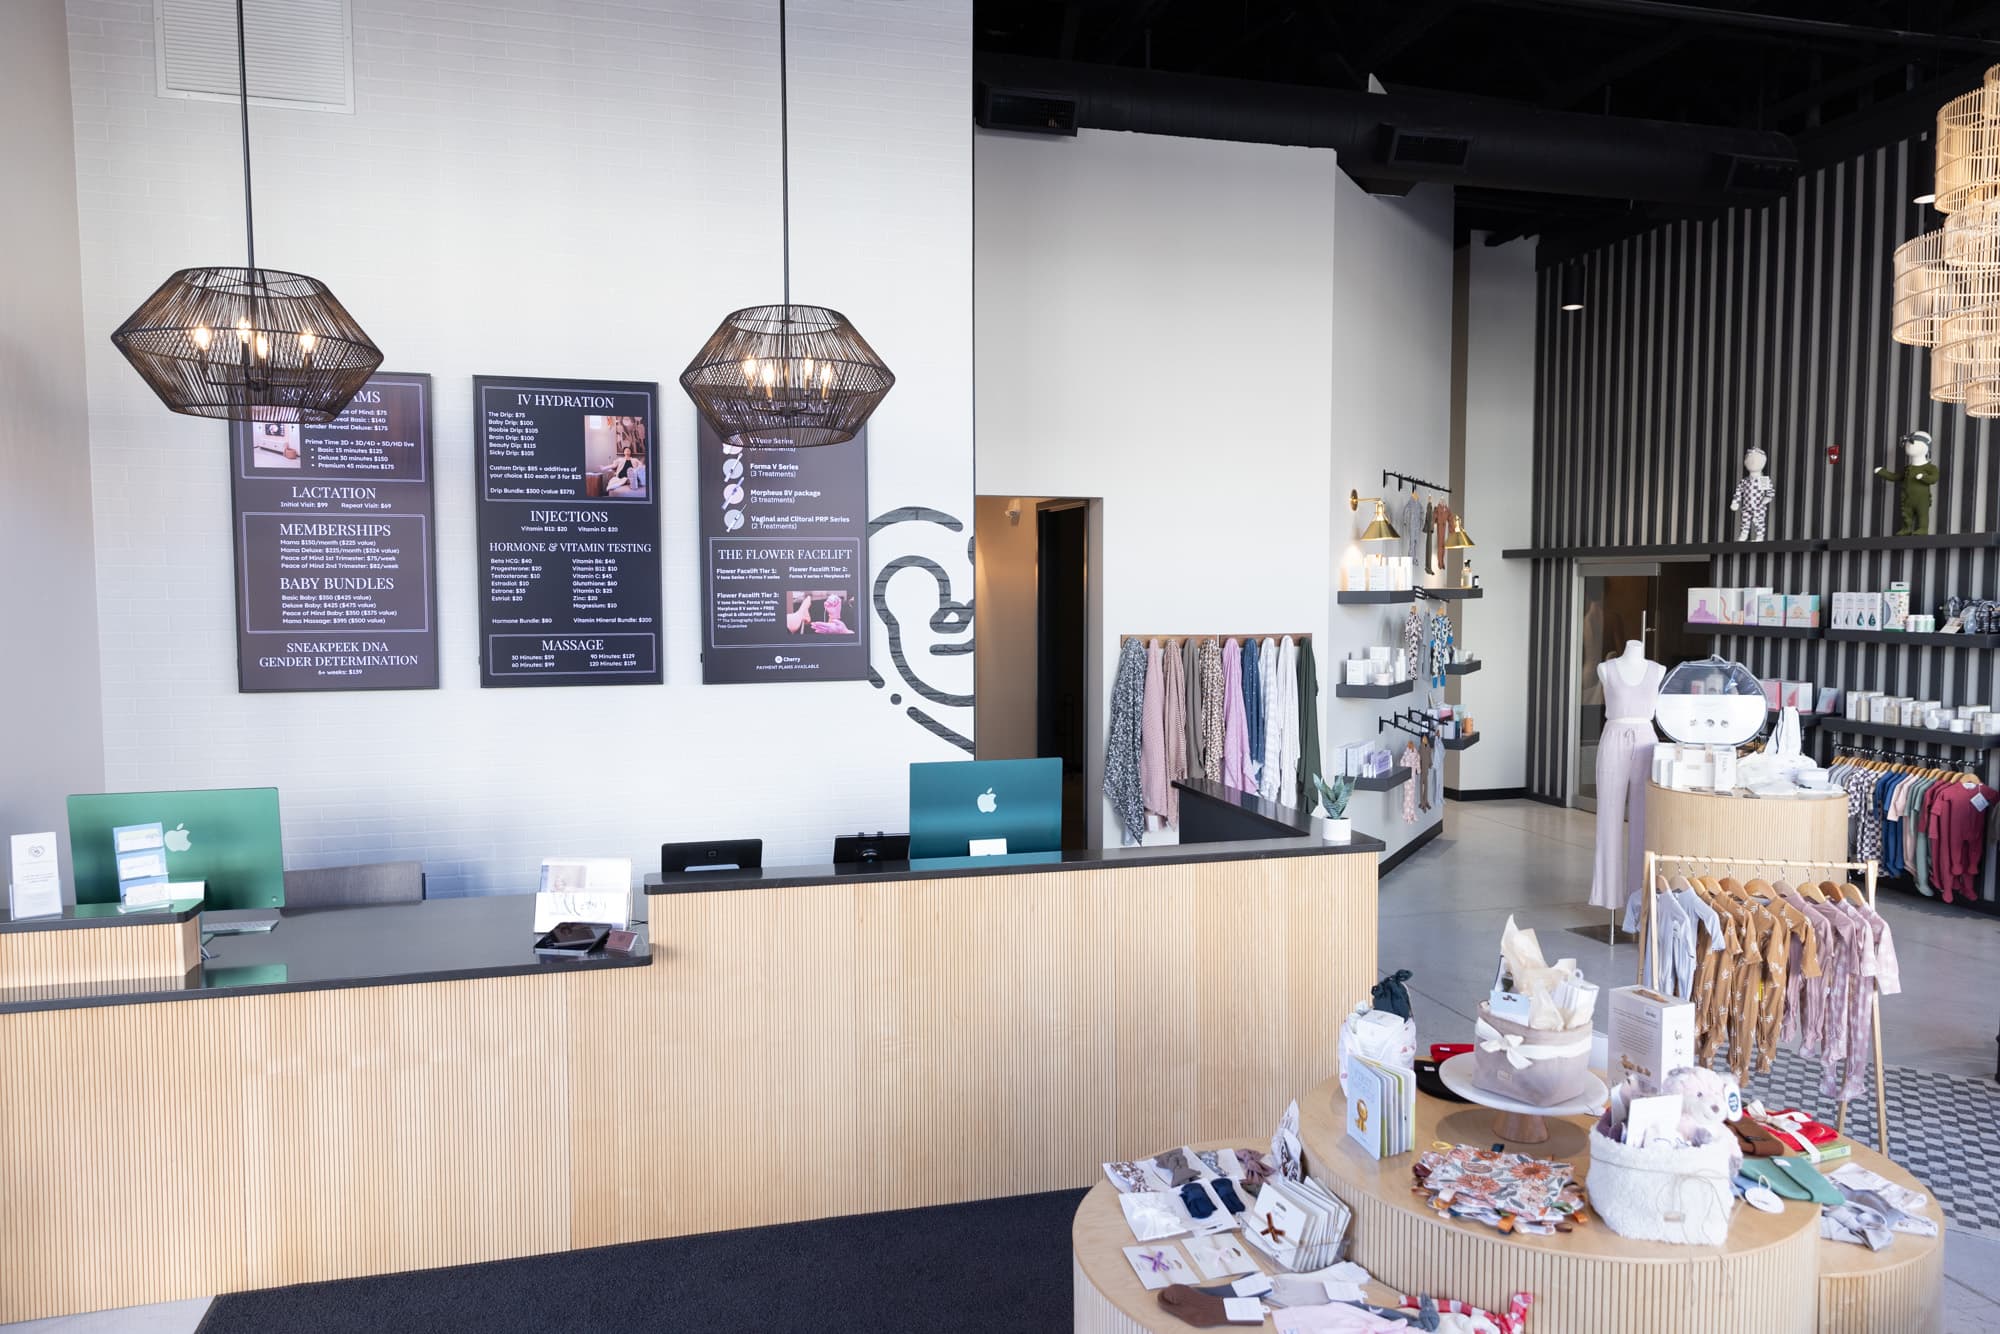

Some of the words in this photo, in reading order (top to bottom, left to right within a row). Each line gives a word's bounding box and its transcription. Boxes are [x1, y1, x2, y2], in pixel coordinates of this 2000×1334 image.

[518, 394, 531, 406] IV
[535, 395, 614, 408] HYDRATION
[293, 486, 376, 499] LACTATION
[531, 510, 608, 523] INJECTIONS
[280, 523, 391, 537] MEMBERSHIPS
[490, 543, 546, 552] HORMONE
[548, 543, 558, 552] &
[560, 543, 604, 552] VITAMIN
[607, 543, 651, 552] TESTING
[718, 550, 743, 560] THE
[746, 550, 795, 560] FLOWER
[797, 549, 853, 560] FACELIFT
[281, 578, 319, 590] BABY
[324, 578, 394, 590] BUNDLES
[287, 642, 359, 653] SNEAKPEEK
[362, 642, 388, 652] DNA
[542, 640, 603, 651] MASSAGE
[259, 656, 312, 667] GENDER
[315, 655, 418, 667] DETERMINATION
